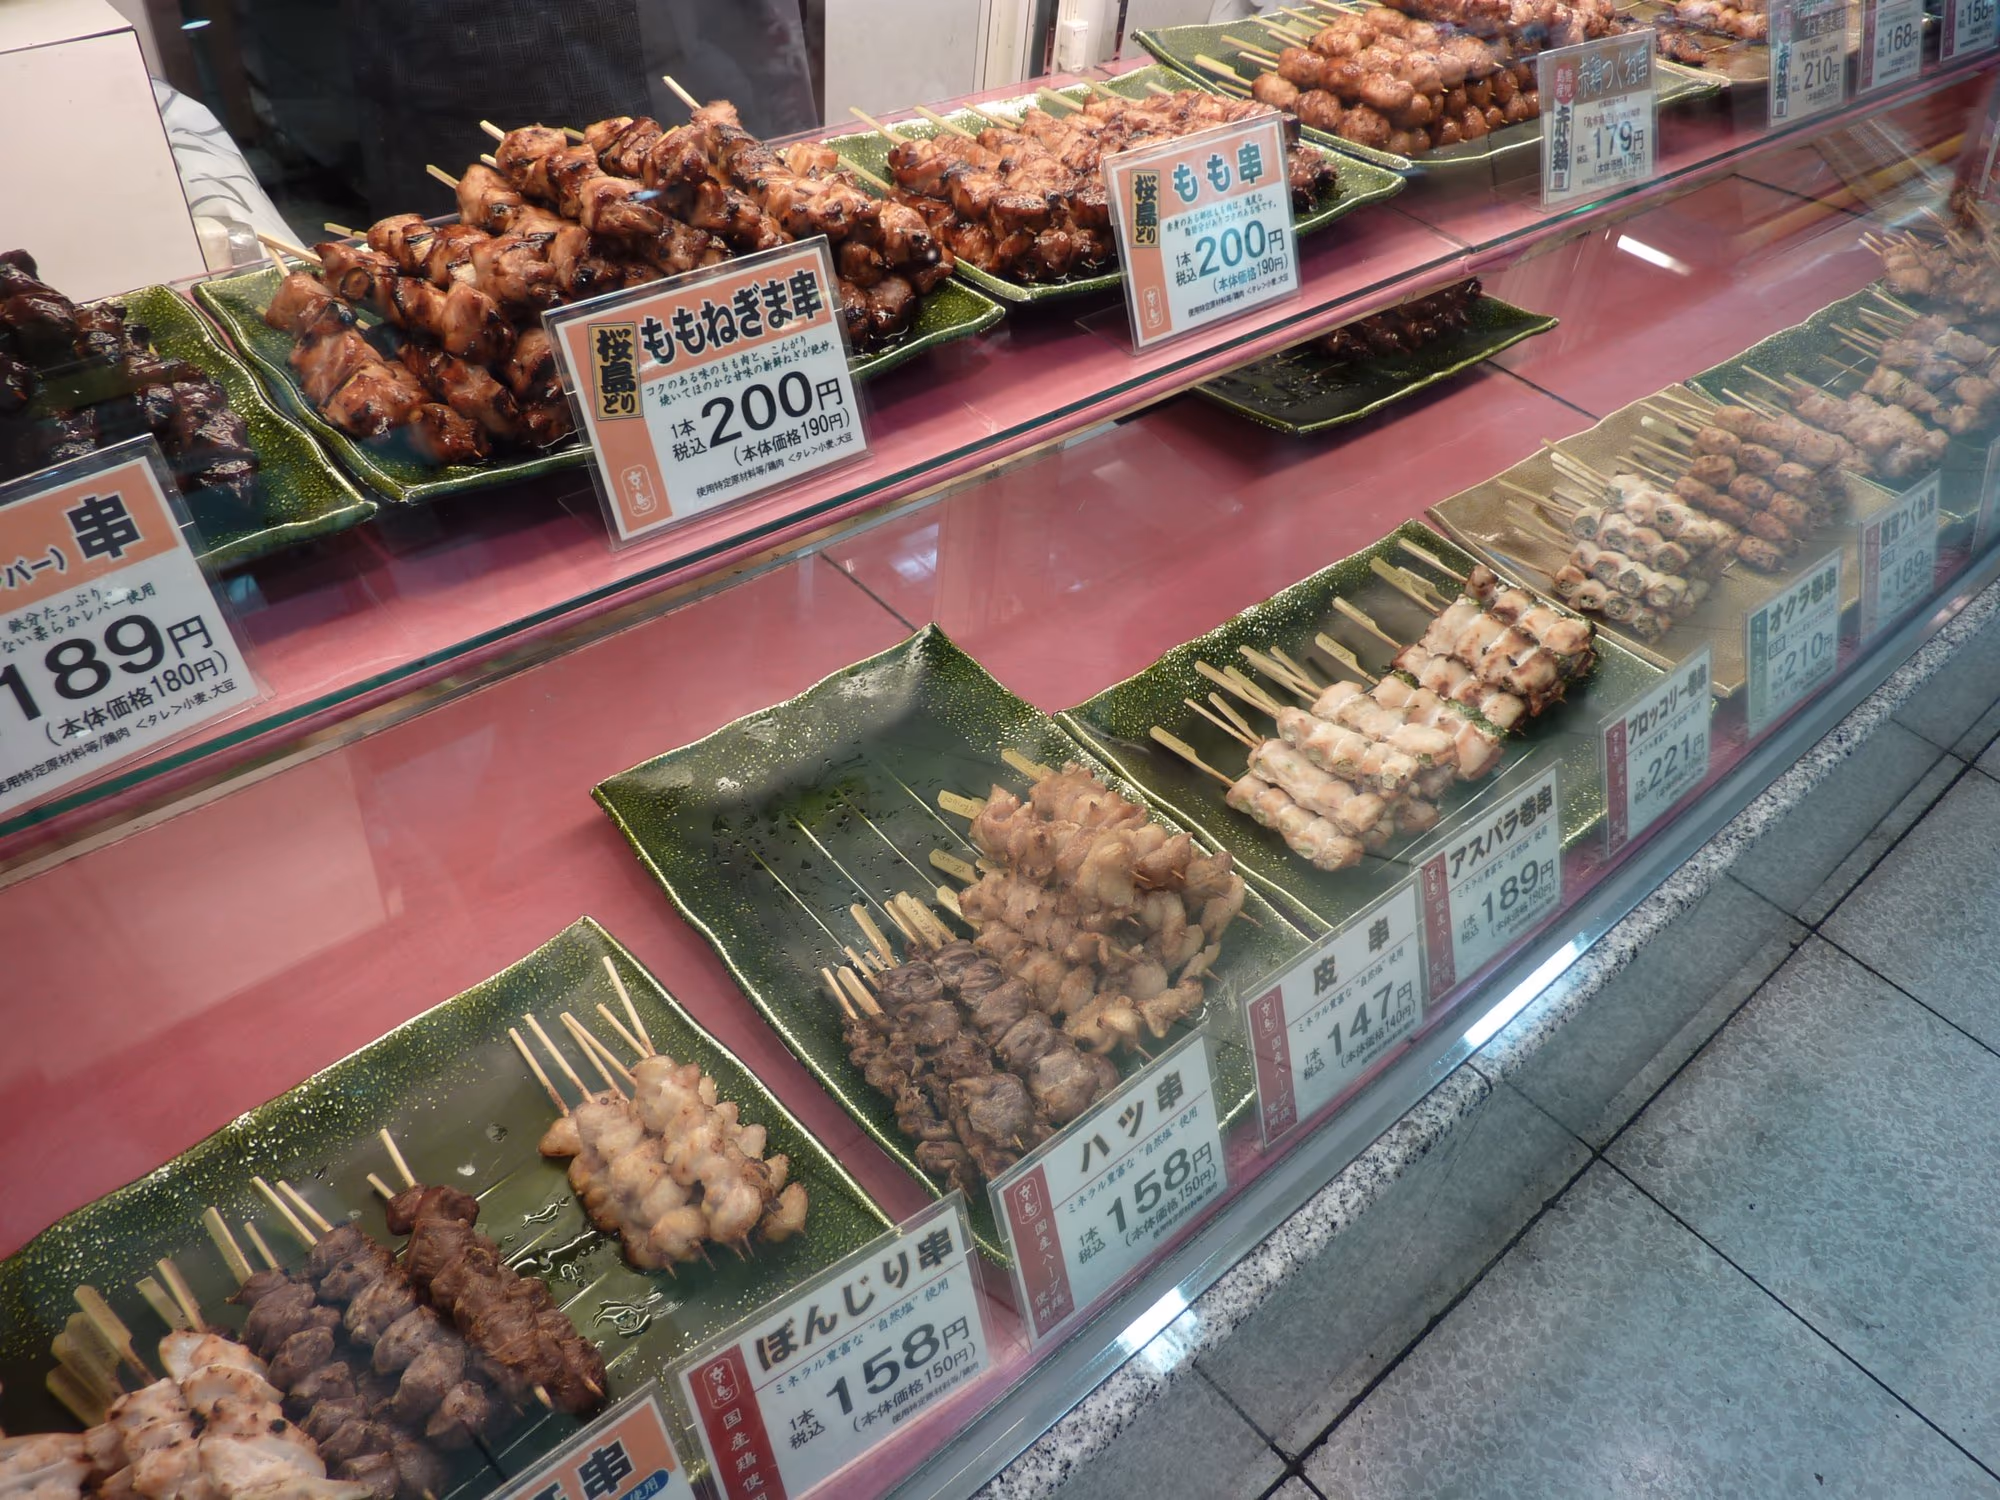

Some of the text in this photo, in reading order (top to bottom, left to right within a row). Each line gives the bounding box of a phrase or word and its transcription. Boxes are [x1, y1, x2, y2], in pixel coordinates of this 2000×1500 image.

[1804, 56, 1840, 89] 210円
[1174, 143, 1263, 202] もも串
[1594, 121, 1644, 158] 179円
[1135, 174, 1157, 244] 桜島どり
[1175, 251, 1191, 267] 1本
[1175, 266, 1196, 286] 税込
[1194, 220, 1284, 278] 200円
[641, 270, 822, 363] ももねぎま串
[597, 329, 636, 414] 桜島どり
[670, 418, 696, 440] 1本
[698, 370, 843, 450] 200円
[732, 407, 851, 467] (本体価格190円)
[671, 436, 707, 462] 税込
[0, 496, 141, 588] バー) 串
[0, 614, 213, 721] 189円
[46, 650, 228, 746] (本体価格180円)
[1648, 732, 1704, 792] 221円
[1450, 785, 1552, 878] アスパラ巻串
[1481, 859, 1553, 928] 189円
[1327, 980, 1412, 1060] 147円
[1303, 1056, 1324, 1081] 税込
[1304, 1045, 1320, 1065] 1本
[1080, 1070, 1184, 1173] ハツ串
[1105, 1142, 1212, 1238] 158円
[1124, 1162, 1217, 1247] (本体価格150円)
[1078, 1235, 1105, 1265] 税込
[1079, 1224, 1098, 1247] 1本
[755, 1227, 953, 1371] ぼんじり串
[774, 1331, 864, 1398] ミネラル豊富な
[924, 1277, 949, 1302] 使用
[824, 1316, 969, 1424] 158円
[789, 1406, 815, 1433] 1本
[852, 1340, 975, 1435] (本体価格150円)
[789, 1416, 825, 1451] 税込
